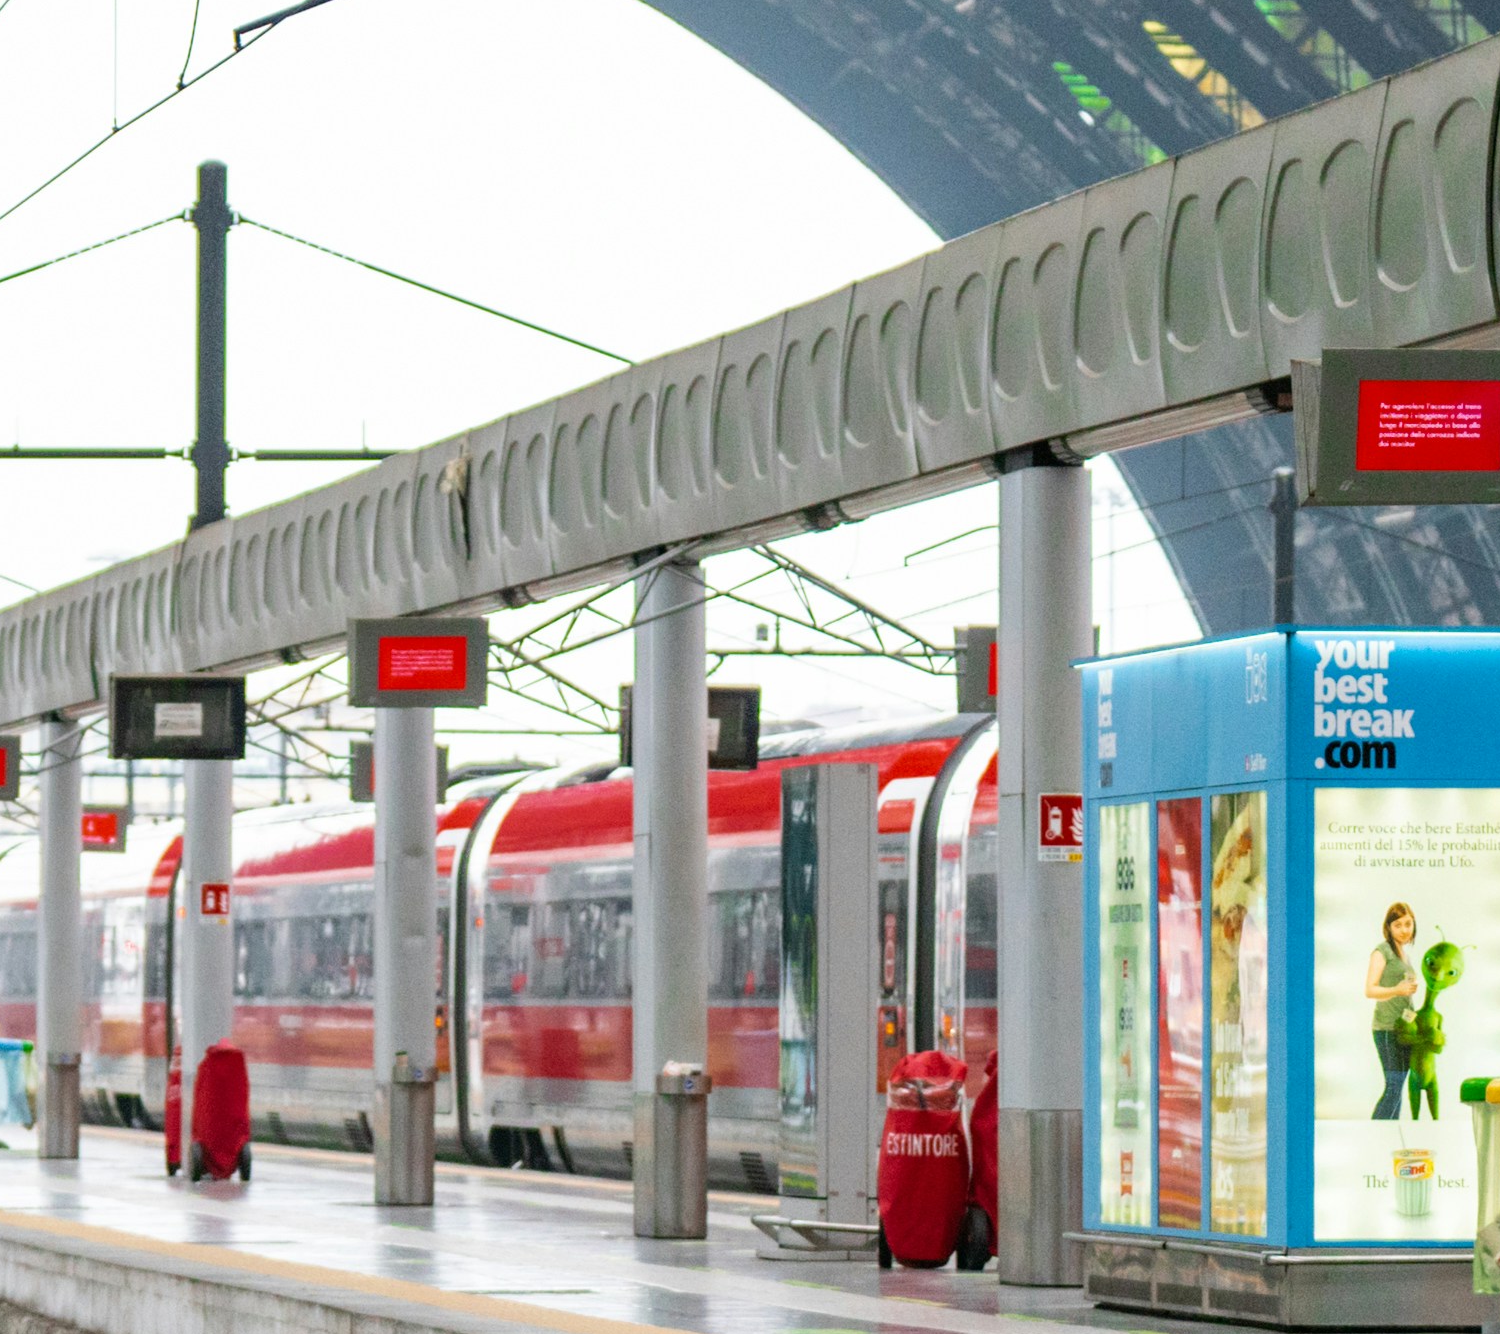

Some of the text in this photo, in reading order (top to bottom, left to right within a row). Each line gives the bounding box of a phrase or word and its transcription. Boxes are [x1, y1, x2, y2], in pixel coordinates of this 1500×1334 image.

[1380, 402, 1391, 410] Per
[1392, 403, 1425, 412] agevolare
[1456, 412, 1482, 421] disporsi
[1404, 422, 1443, 430] marciapiede
[1379, 431, 1409, 439] posizione
[1314, 640, 1396, 672] your
[1314, 671, 1389, 704] best
[1314, 704, 1416, 739] break
[1314, 739, 1397, 770] .com
[1328, 822, 1365, 834] Corre
[1368, 825, 1397, 834] voce
[1400, 822, 1424, 834] che
[1425, 822, 1452, 834] bere
[1320, 840, 1371, 851] aumenti
[1374, 839, 1393, 851] del
[1398, 839, 1424, 851] 15%
[1428, 839, 1439, 851] le
[1354, 856, 1475, 868] di avvistare un Ufo.
[887, 1133, 959, 1157] ESTINTORE
[1363, 1175, 1470, 1188] Thé best.
